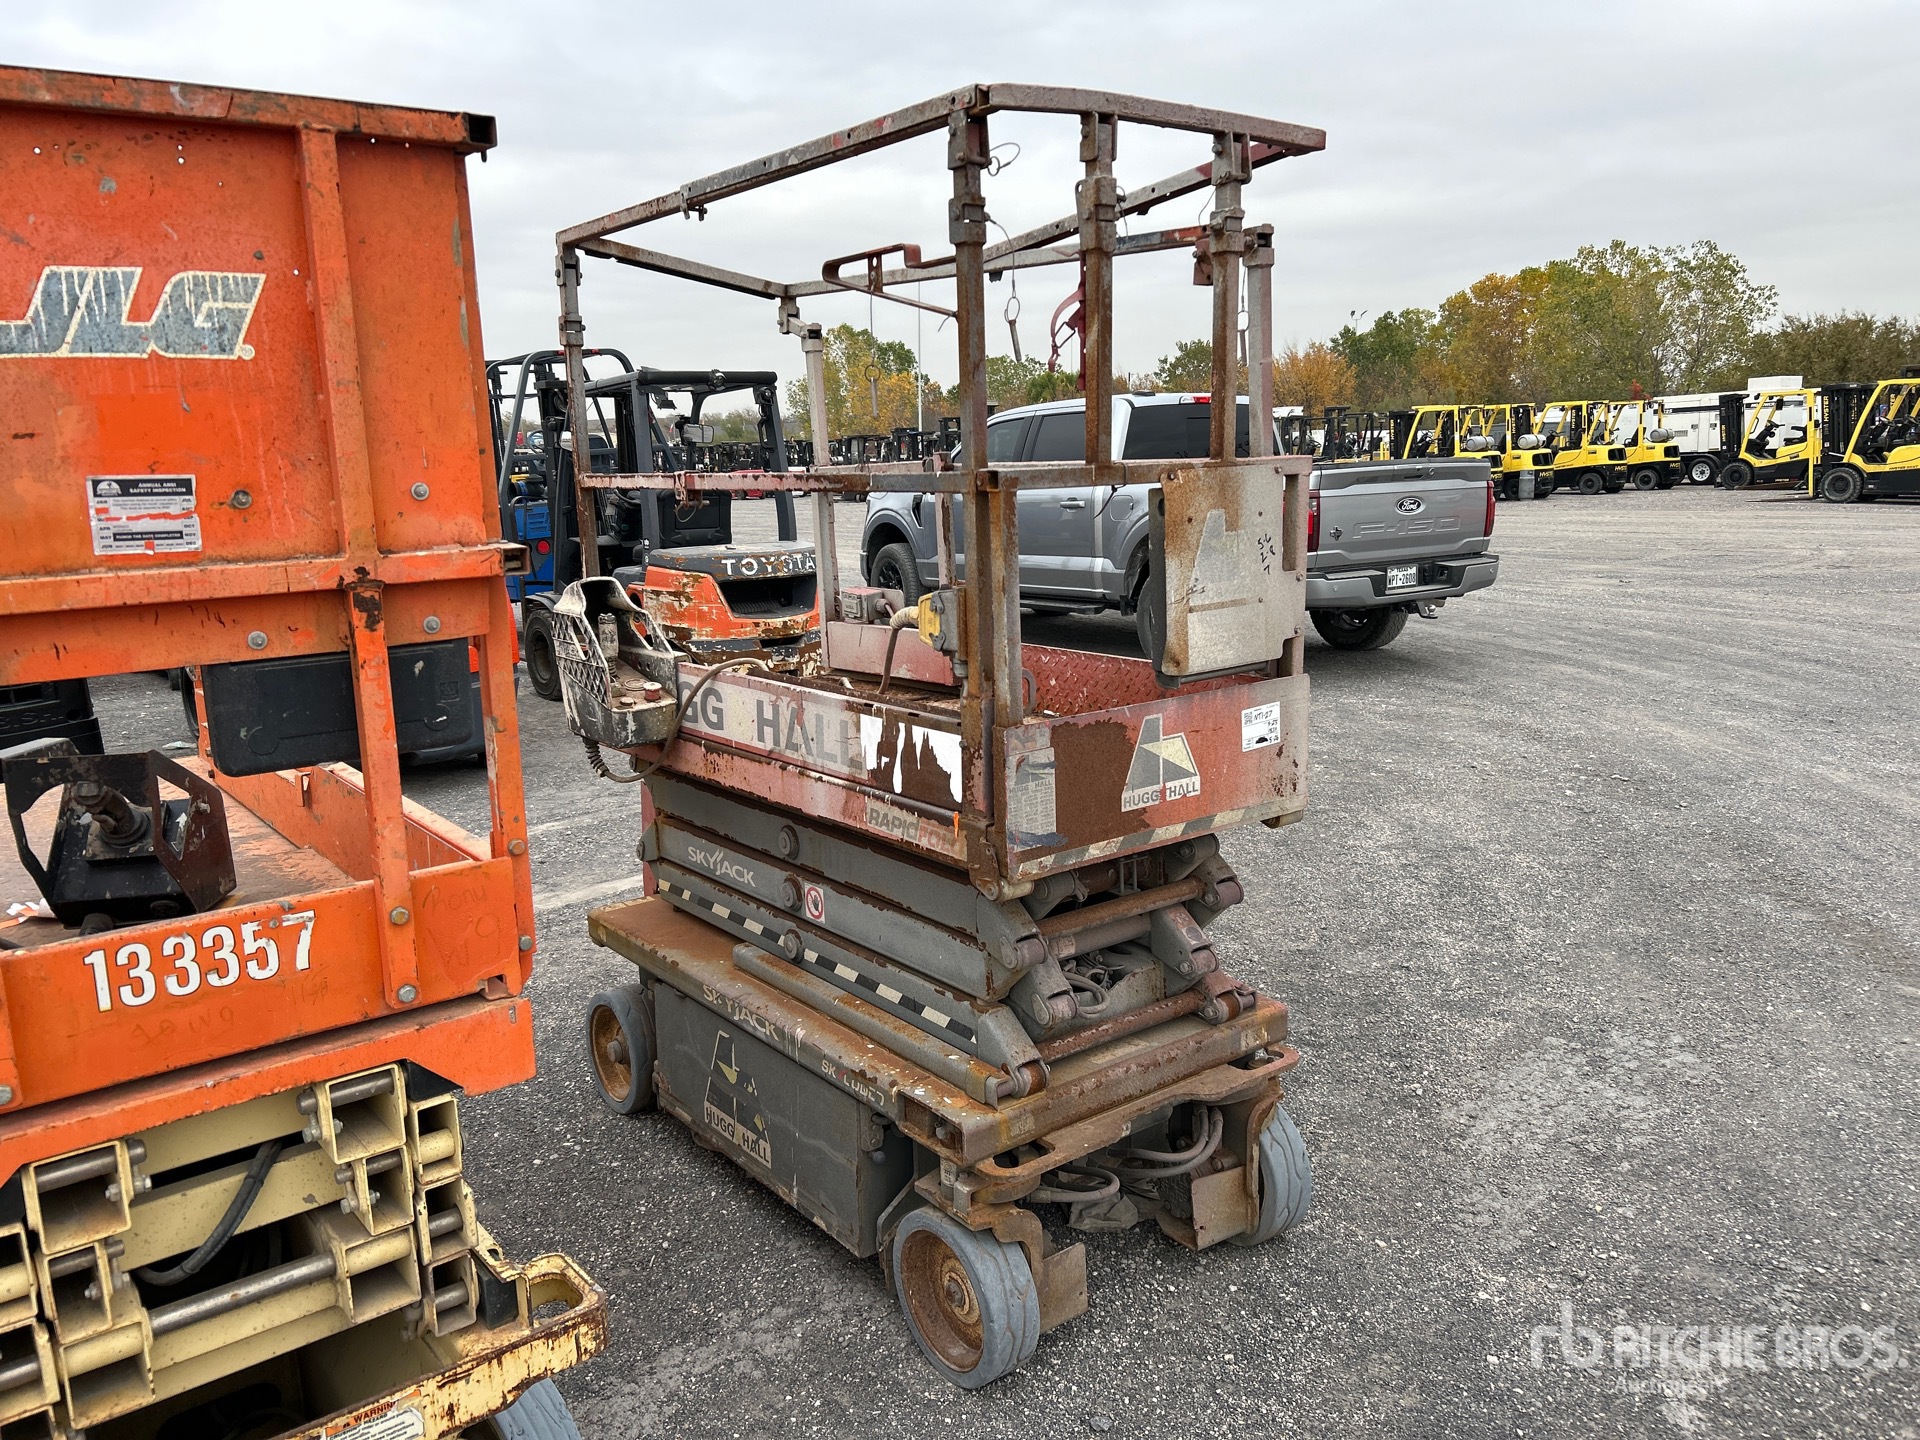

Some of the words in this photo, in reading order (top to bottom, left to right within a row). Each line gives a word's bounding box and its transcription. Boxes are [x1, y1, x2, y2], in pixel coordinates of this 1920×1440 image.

[0, 265, 267, 360] JLG
[1353, 516, 1460, 539] F-150
[1401, 500, 1419, 511] Ford
[678, 681, 725, 731] GG
[1123, 790, 1160, 808] HUGG
[1168, 781, 1199, 799] HALL
[687, 846, 756, 888] SKYJACK
[83, 909, 316, 1013] 133357
[703, 984, 780, 1041] SKYJACK
[705, 1106, 735, 1140] HUGG
[741, 1132, 770, 1164] HALL
